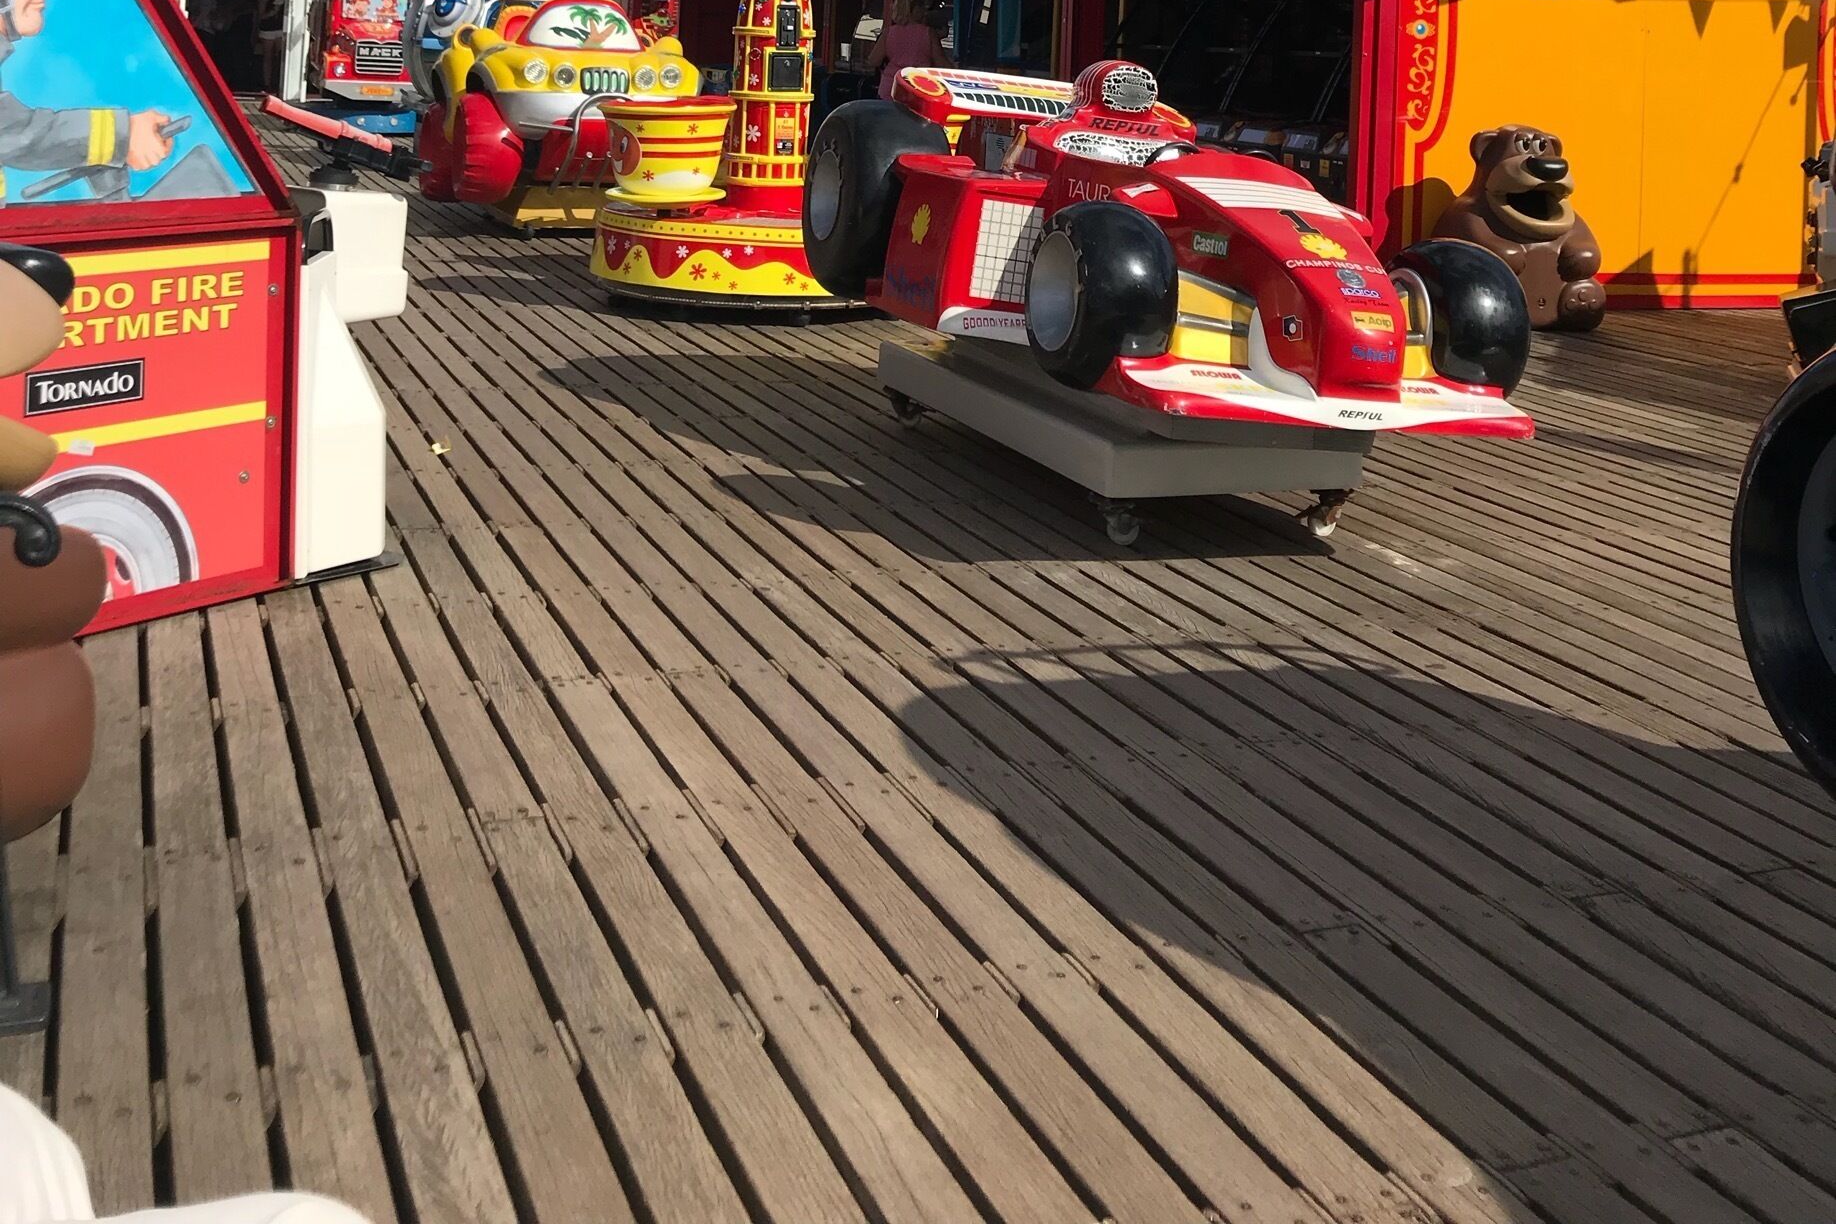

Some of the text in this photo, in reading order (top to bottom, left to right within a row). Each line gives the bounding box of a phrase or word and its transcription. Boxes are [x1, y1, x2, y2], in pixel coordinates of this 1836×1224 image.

[359, 47, 403, 58] MACK
[1068, 178, 1111, 202] TAUR
[1277, 209, 1323, 235] 1
[151, 271, 244, 305] FIRE
